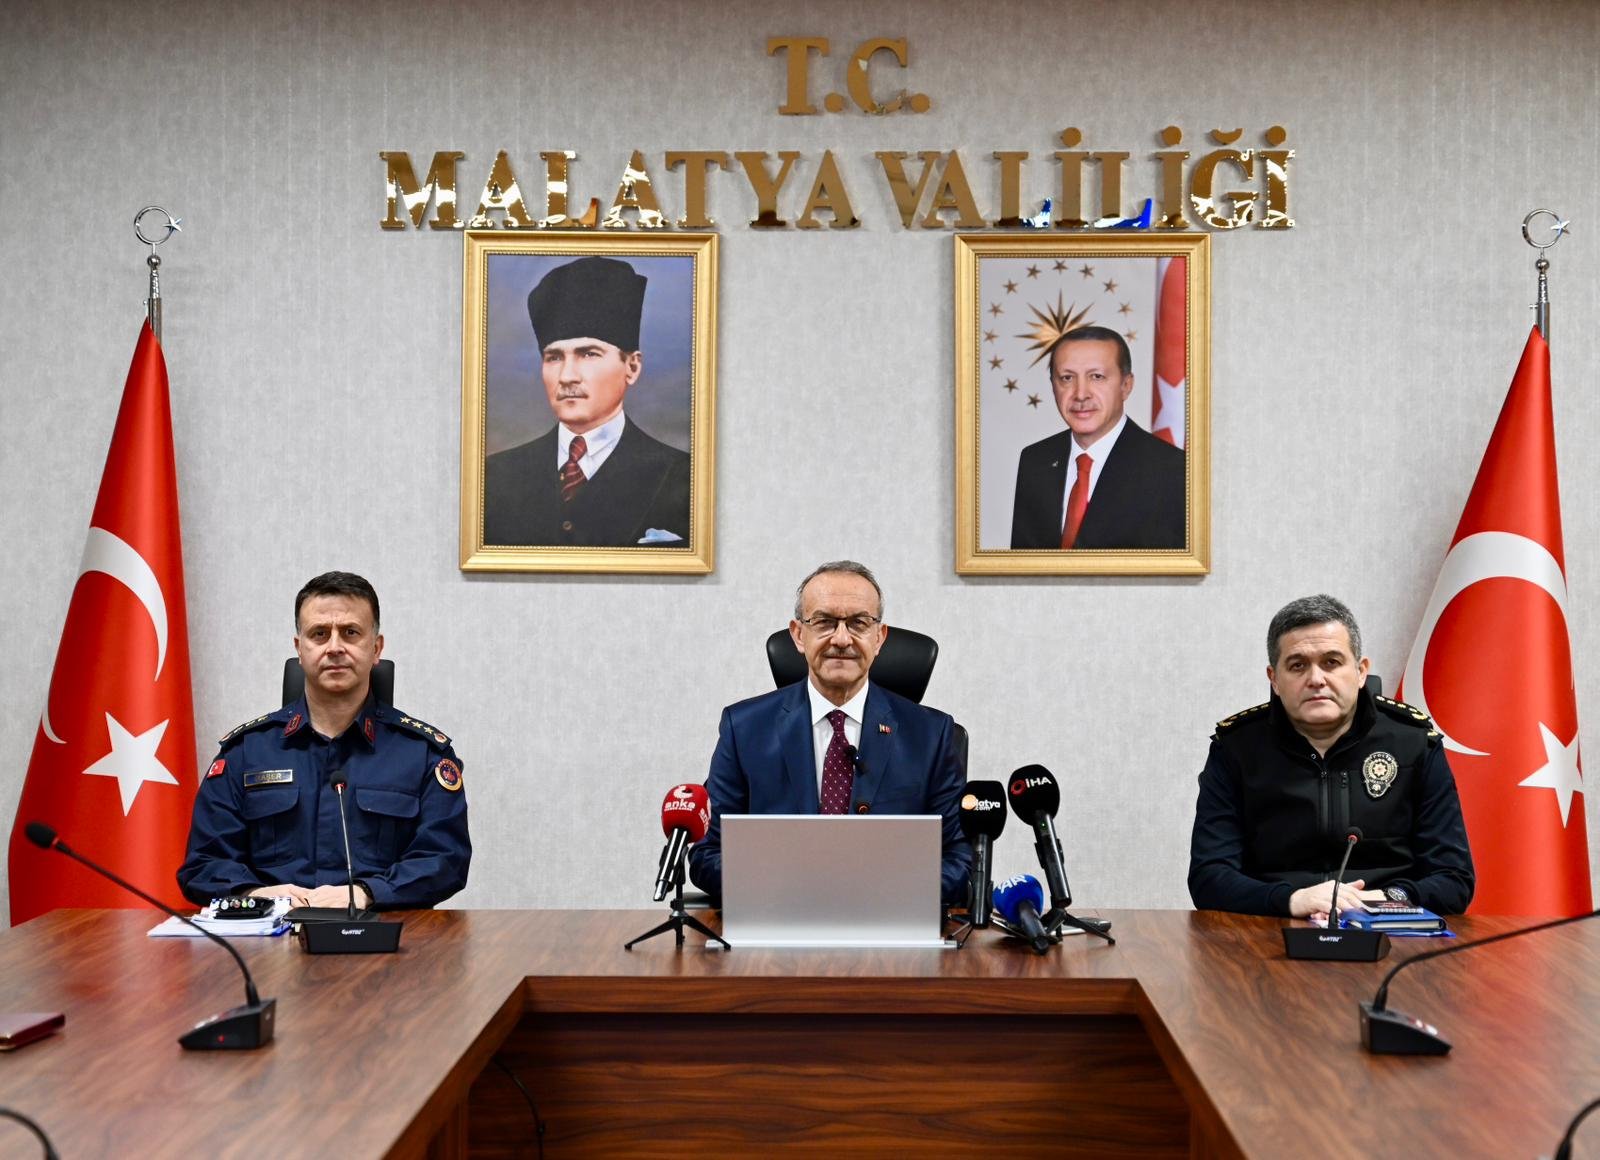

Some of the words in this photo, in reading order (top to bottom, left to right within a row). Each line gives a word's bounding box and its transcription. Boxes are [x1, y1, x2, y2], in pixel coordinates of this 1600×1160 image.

[767, 37, 930, 115] T.C.
[379, 149, 862, 229] MALATYA
[875, 125, 1296, 229] VALİLİĞİ
